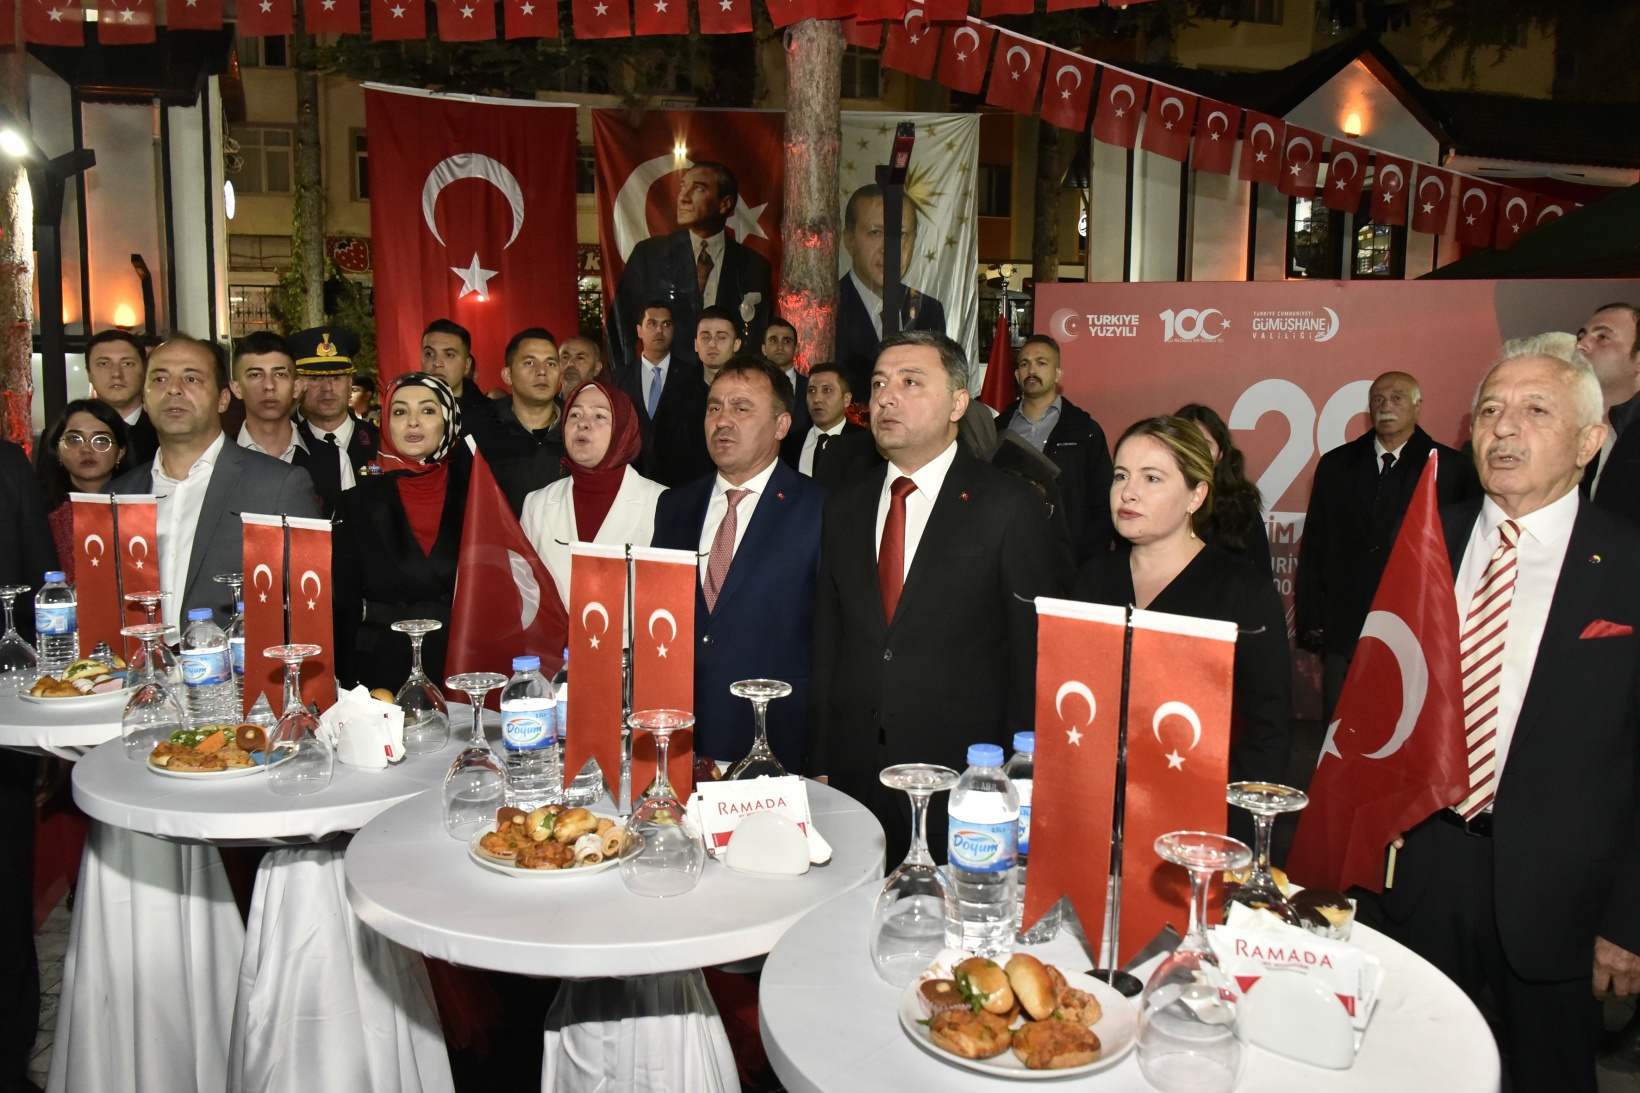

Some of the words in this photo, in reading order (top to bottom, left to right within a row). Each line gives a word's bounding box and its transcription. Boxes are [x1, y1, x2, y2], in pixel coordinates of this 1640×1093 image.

[1087, 314, 1139, 325] TÜRKİYE
[1252, 318, 1326, 333] GÜMÜŞHANE
[1089, 326, 1137, 337] YÜZYILI
[1252, 331, 1313, 340] VALİLİĞİ
[506, 722, 542, 737] Doyum
[718, 797, 787, 815] RAMADA
[953, 834, 999, 856] Doyum
[1235, 938, 1333, 969] RAMADA
